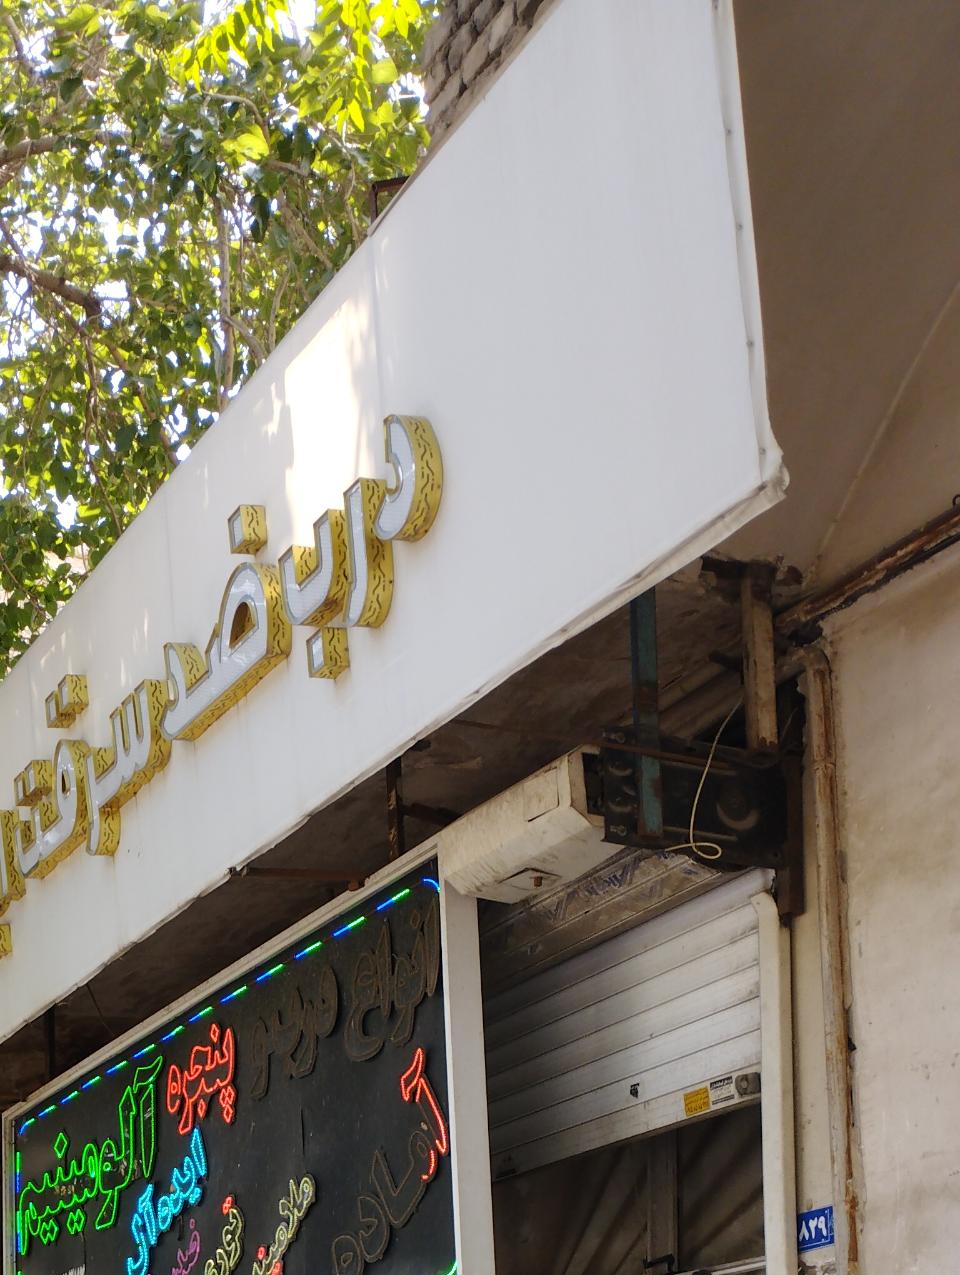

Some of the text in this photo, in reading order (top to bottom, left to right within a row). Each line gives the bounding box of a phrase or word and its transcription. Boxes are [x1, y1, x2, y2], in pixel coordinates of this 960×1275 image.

[161, 504, 293, 741] ضد
[277, 413, 444, 680] درب
[14, 674, 171, 880] سرقت
[345, 896, 440, 1063] انواع
[167, 1021, 238, 1135] پنجره
[798, 1215, 828, 1243] ۸۲۹
